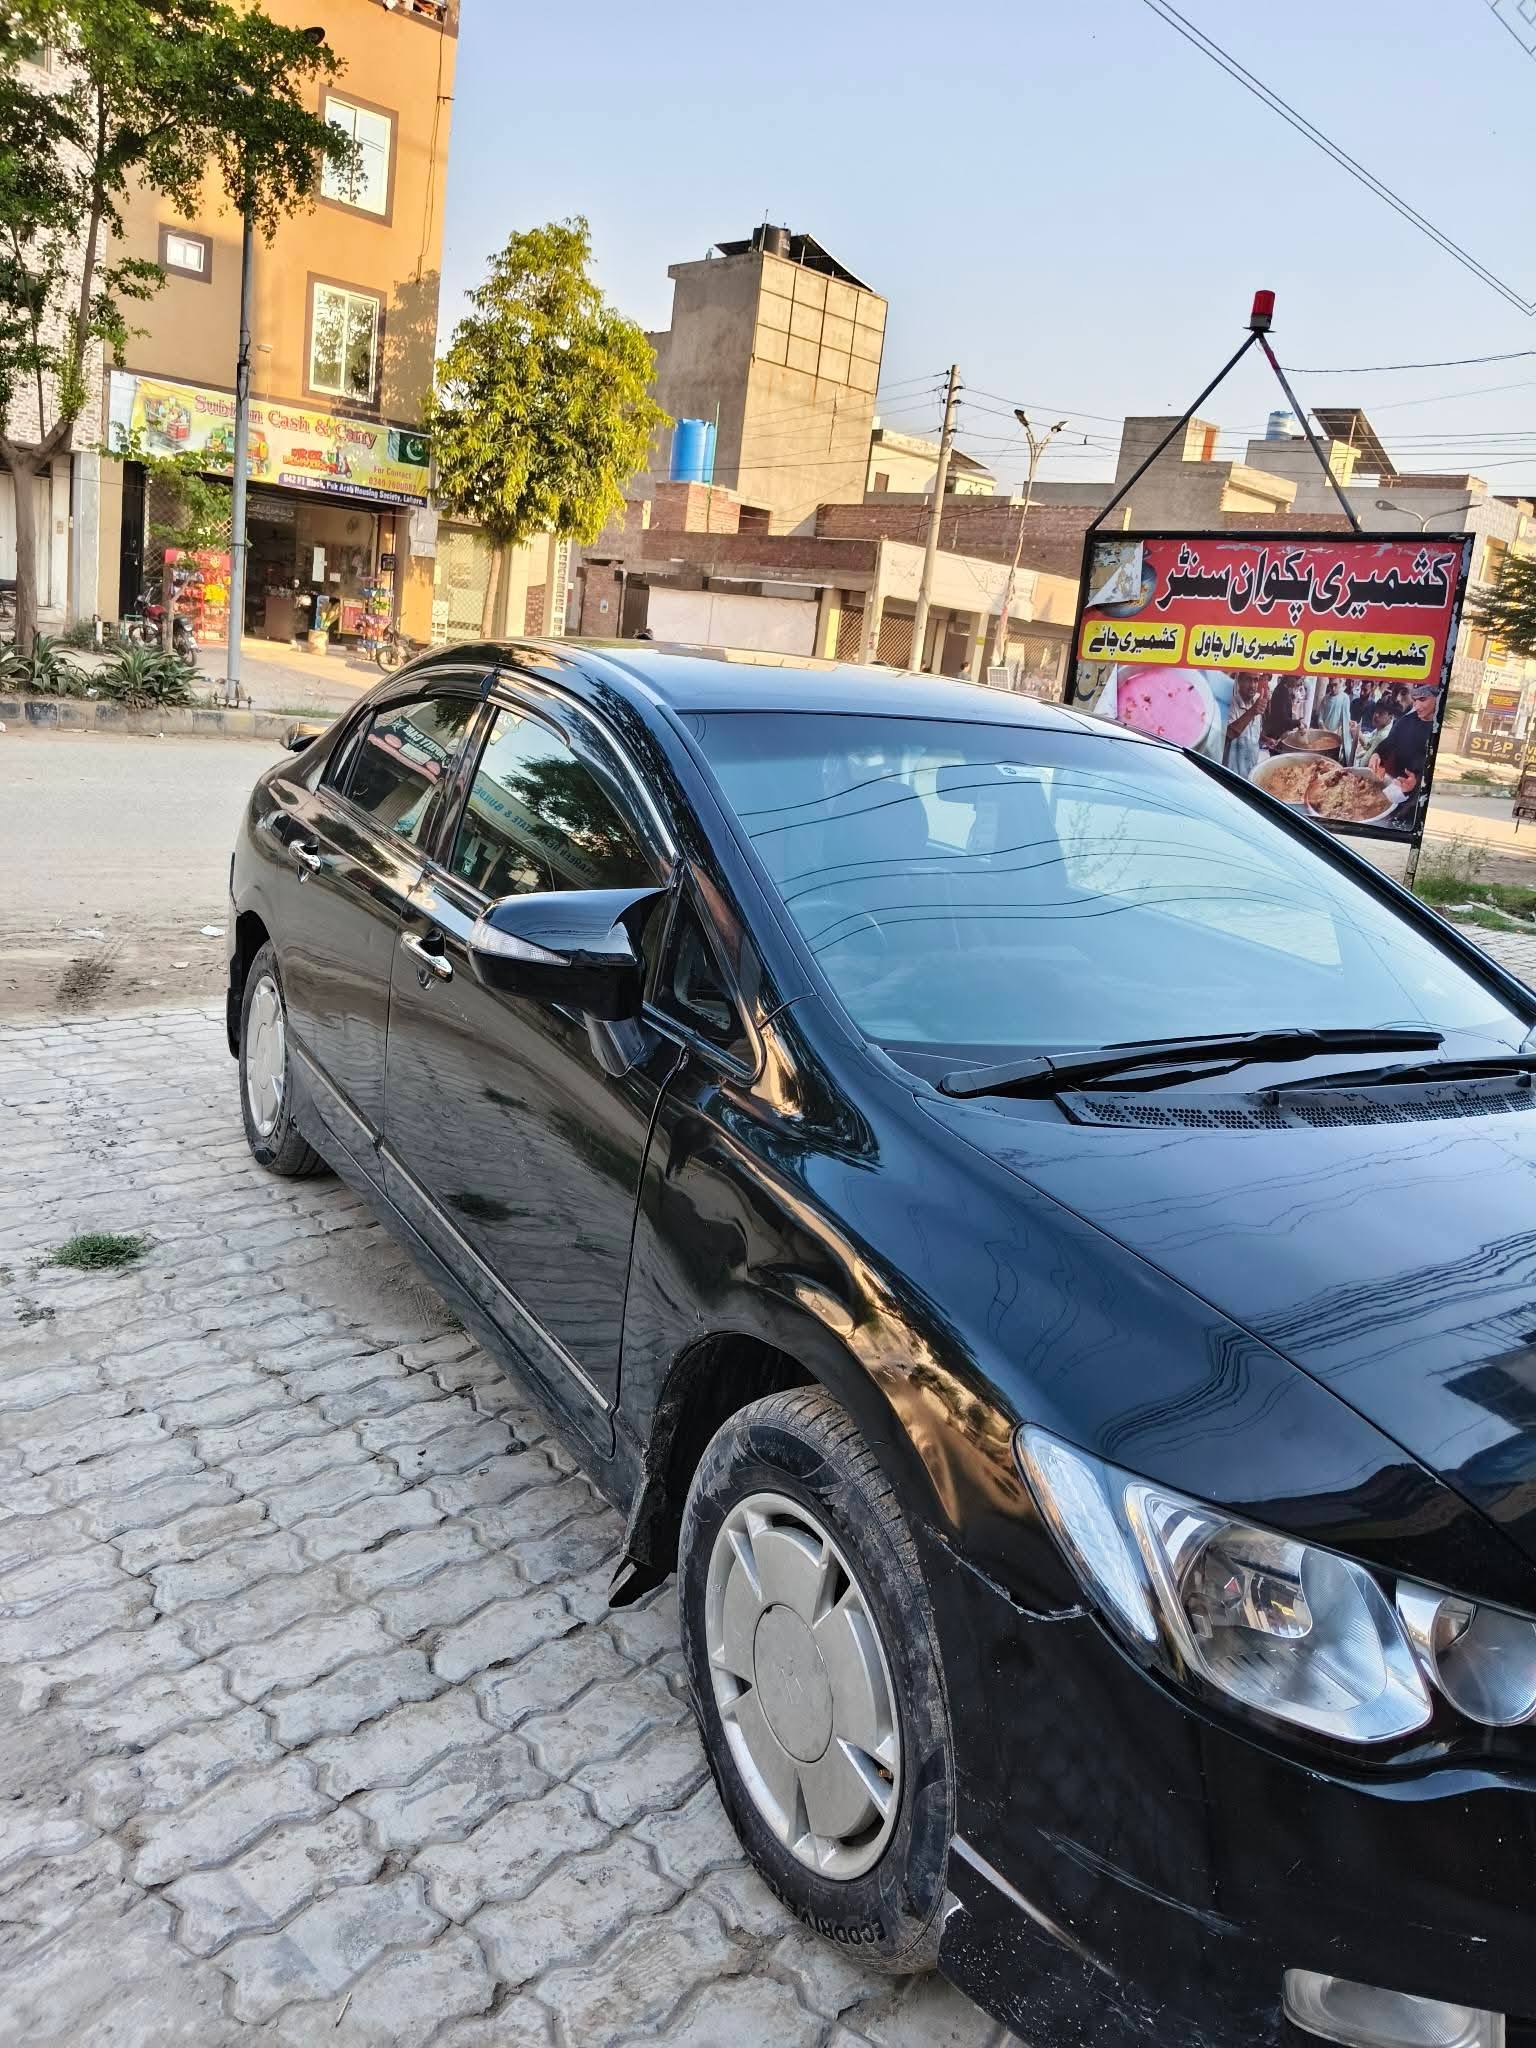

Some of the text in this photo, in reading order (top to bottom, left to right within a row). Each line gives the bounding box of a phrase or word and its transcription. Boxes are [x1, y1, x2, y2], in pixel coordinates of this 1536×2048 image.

[268, 410, 310, 434] Cash
[315, 419, 331, 438] &
[334, 423, 378, 450] Carry
[339, 482, 354, 494] Arab
[354, 485, 378, 499] Housing
[1156, 543, 1456, 626] کشمیری پکوان سنٹر
[1119, 627, 1178, 654] کشمیری
[1194, 630, 1223, 661] چاول
[1244, 633, 1297, 661] کشمیری
[1309, 639, 1429, 669] کشمیری بریانی
